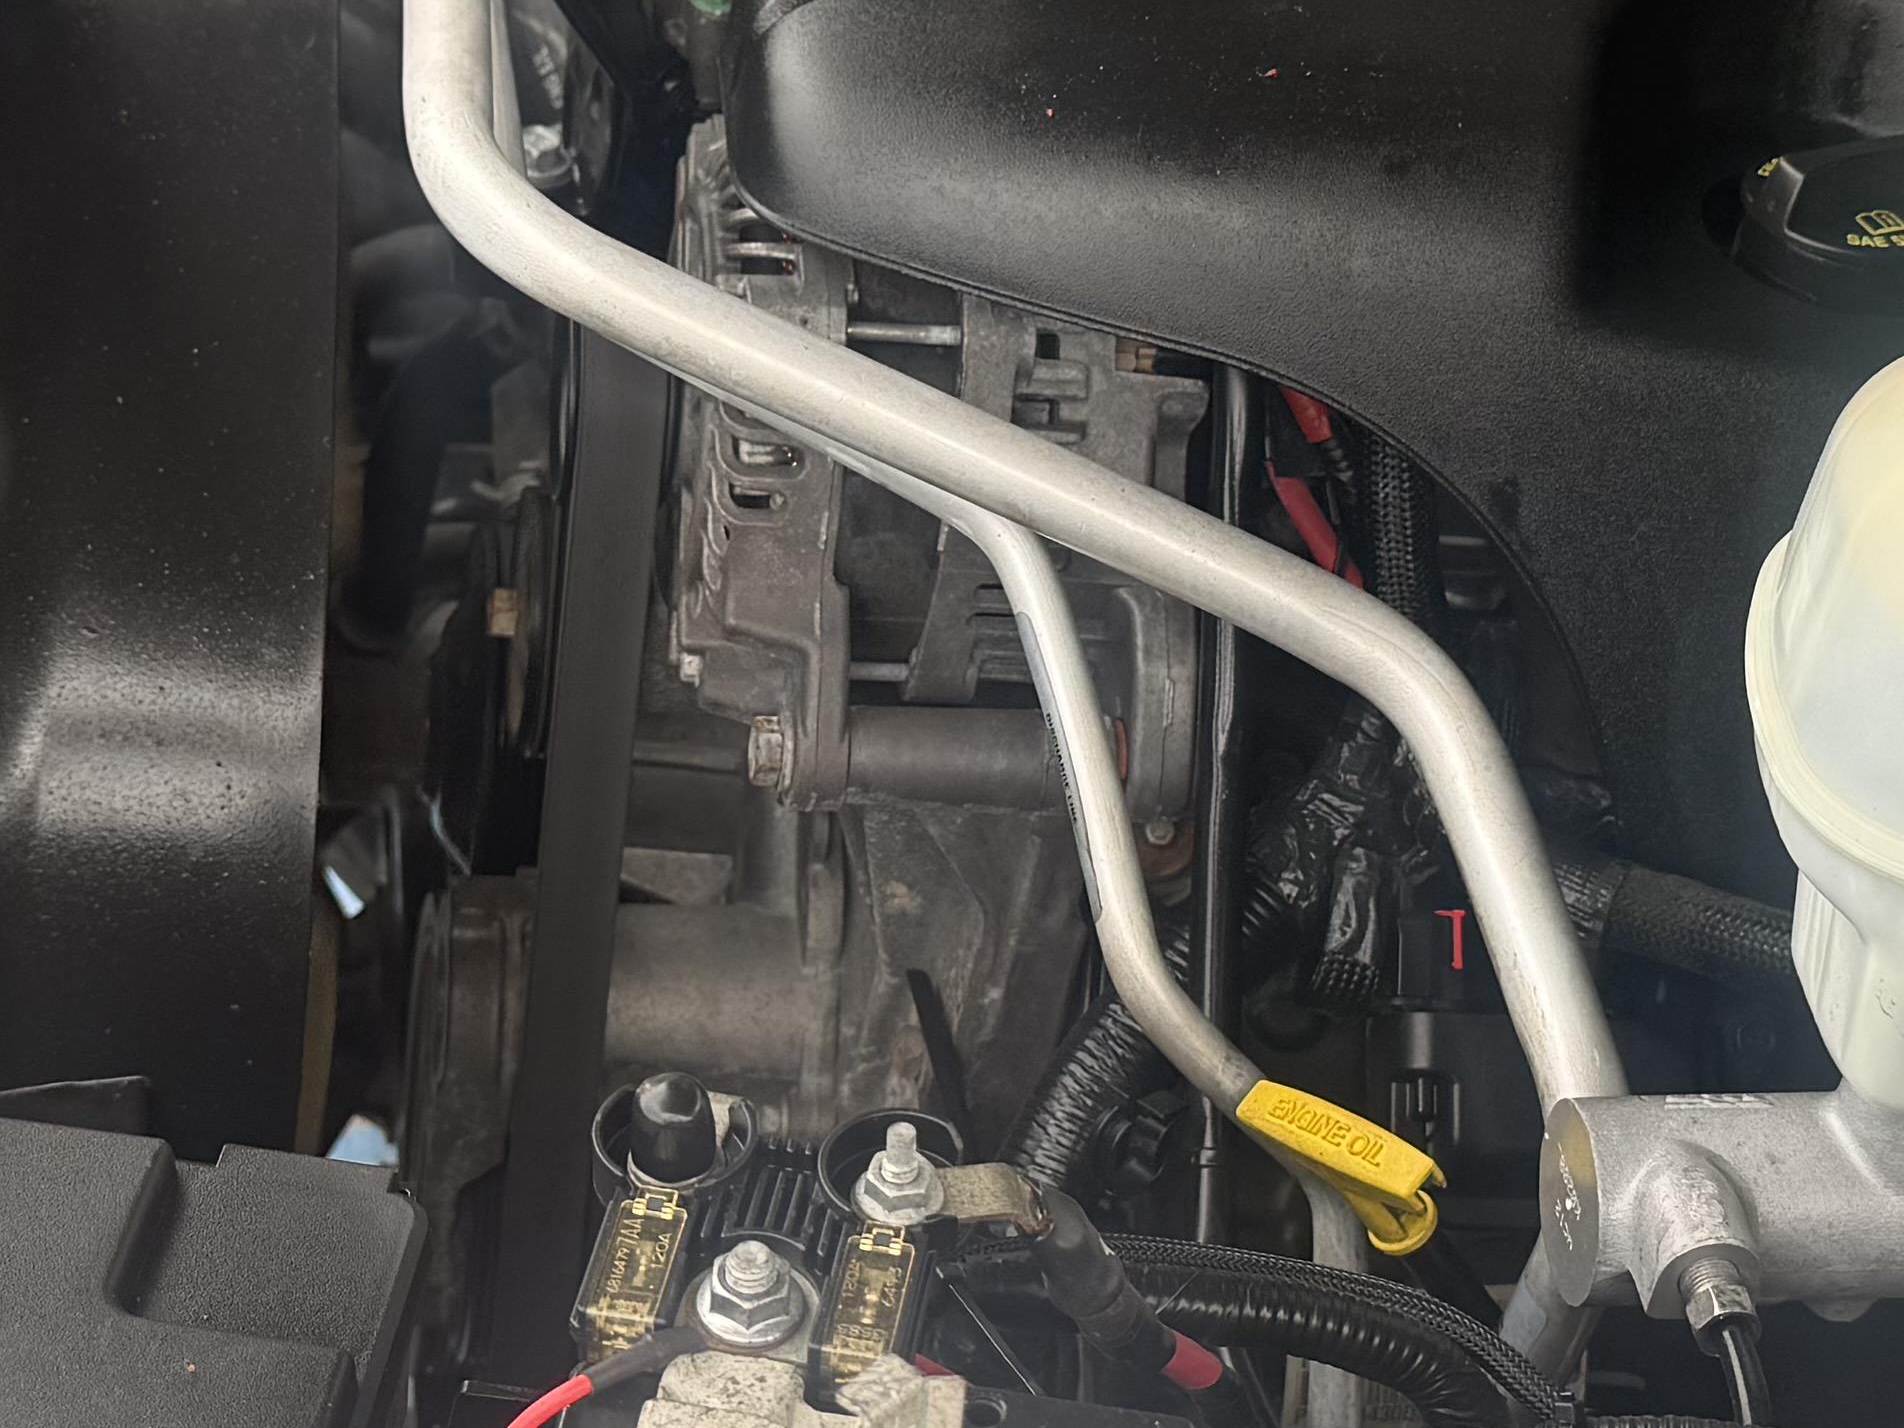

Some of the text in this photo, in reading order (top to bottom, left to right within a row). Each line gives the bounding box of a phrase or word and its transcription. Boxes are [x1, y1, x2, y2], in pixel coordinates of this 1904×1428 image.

[1846, 232, 1889, 248] SAE
[1266, 1098, 1386, 1168] ENGINE OIL
[650, 1231, 674, 1271] 120A
